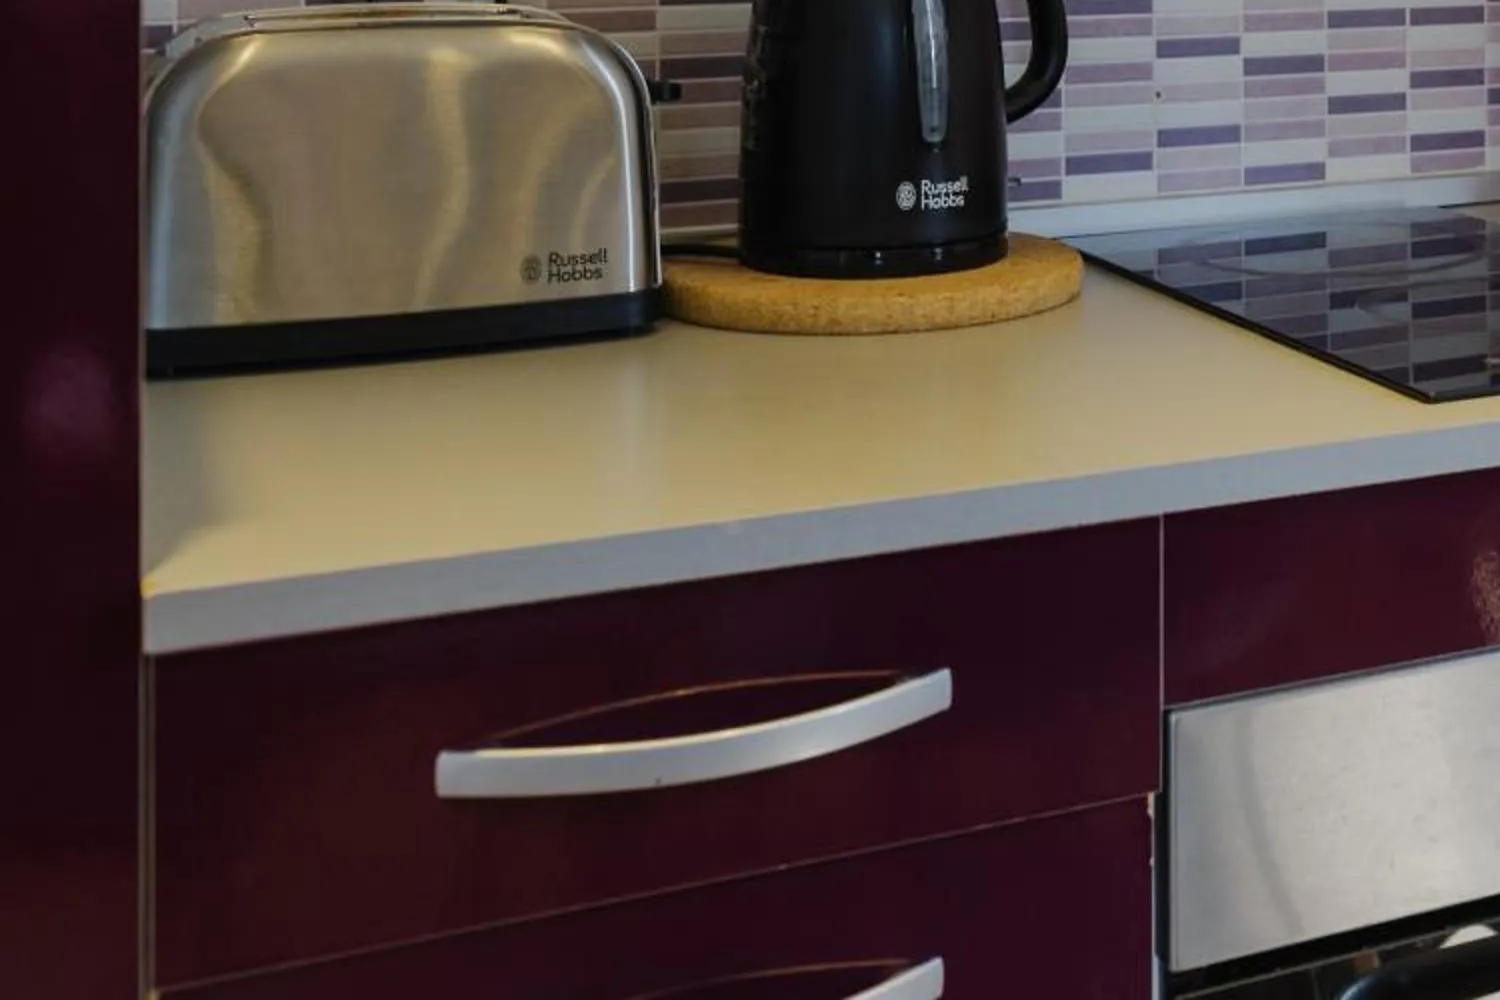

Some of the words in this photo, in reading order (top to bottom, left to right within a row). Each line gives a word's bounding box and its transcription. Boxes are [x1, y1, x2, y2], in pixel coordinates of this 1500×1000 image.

[920, 176, 968, 195] Russell
[920, 192, 965, 211] Hobbs
[548, 248, 608, 267] Russell
[547, 266, 602, 284] Hobbs
